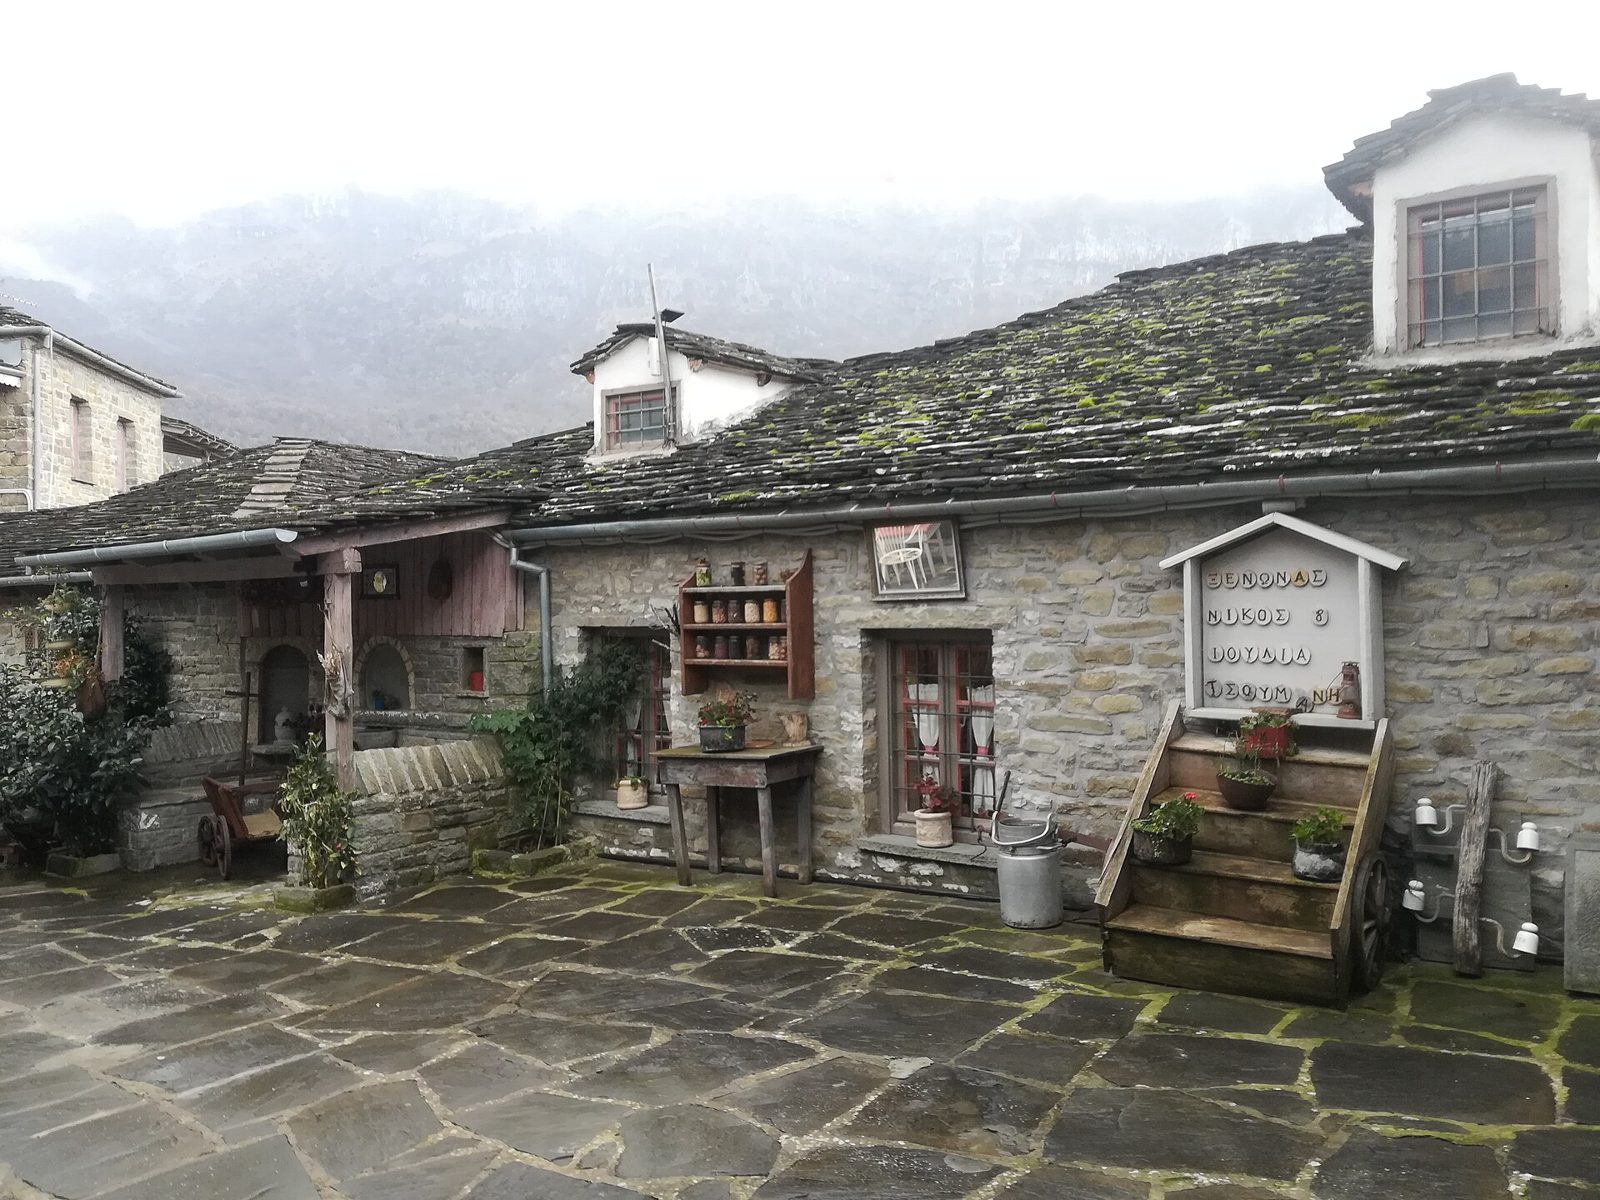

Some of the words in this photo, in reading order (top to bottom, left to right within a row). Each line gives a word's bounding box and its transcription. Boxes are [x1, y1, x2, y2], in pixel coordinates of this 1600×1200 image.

[1207, 570, 1324, 586] ΞΕΝΩΝΑΣ
[1207, 608, 1287, 623] ΝΙΚΟΣ
[1212, 646, 1308, 662] ΙΟΥΛΙΑ
